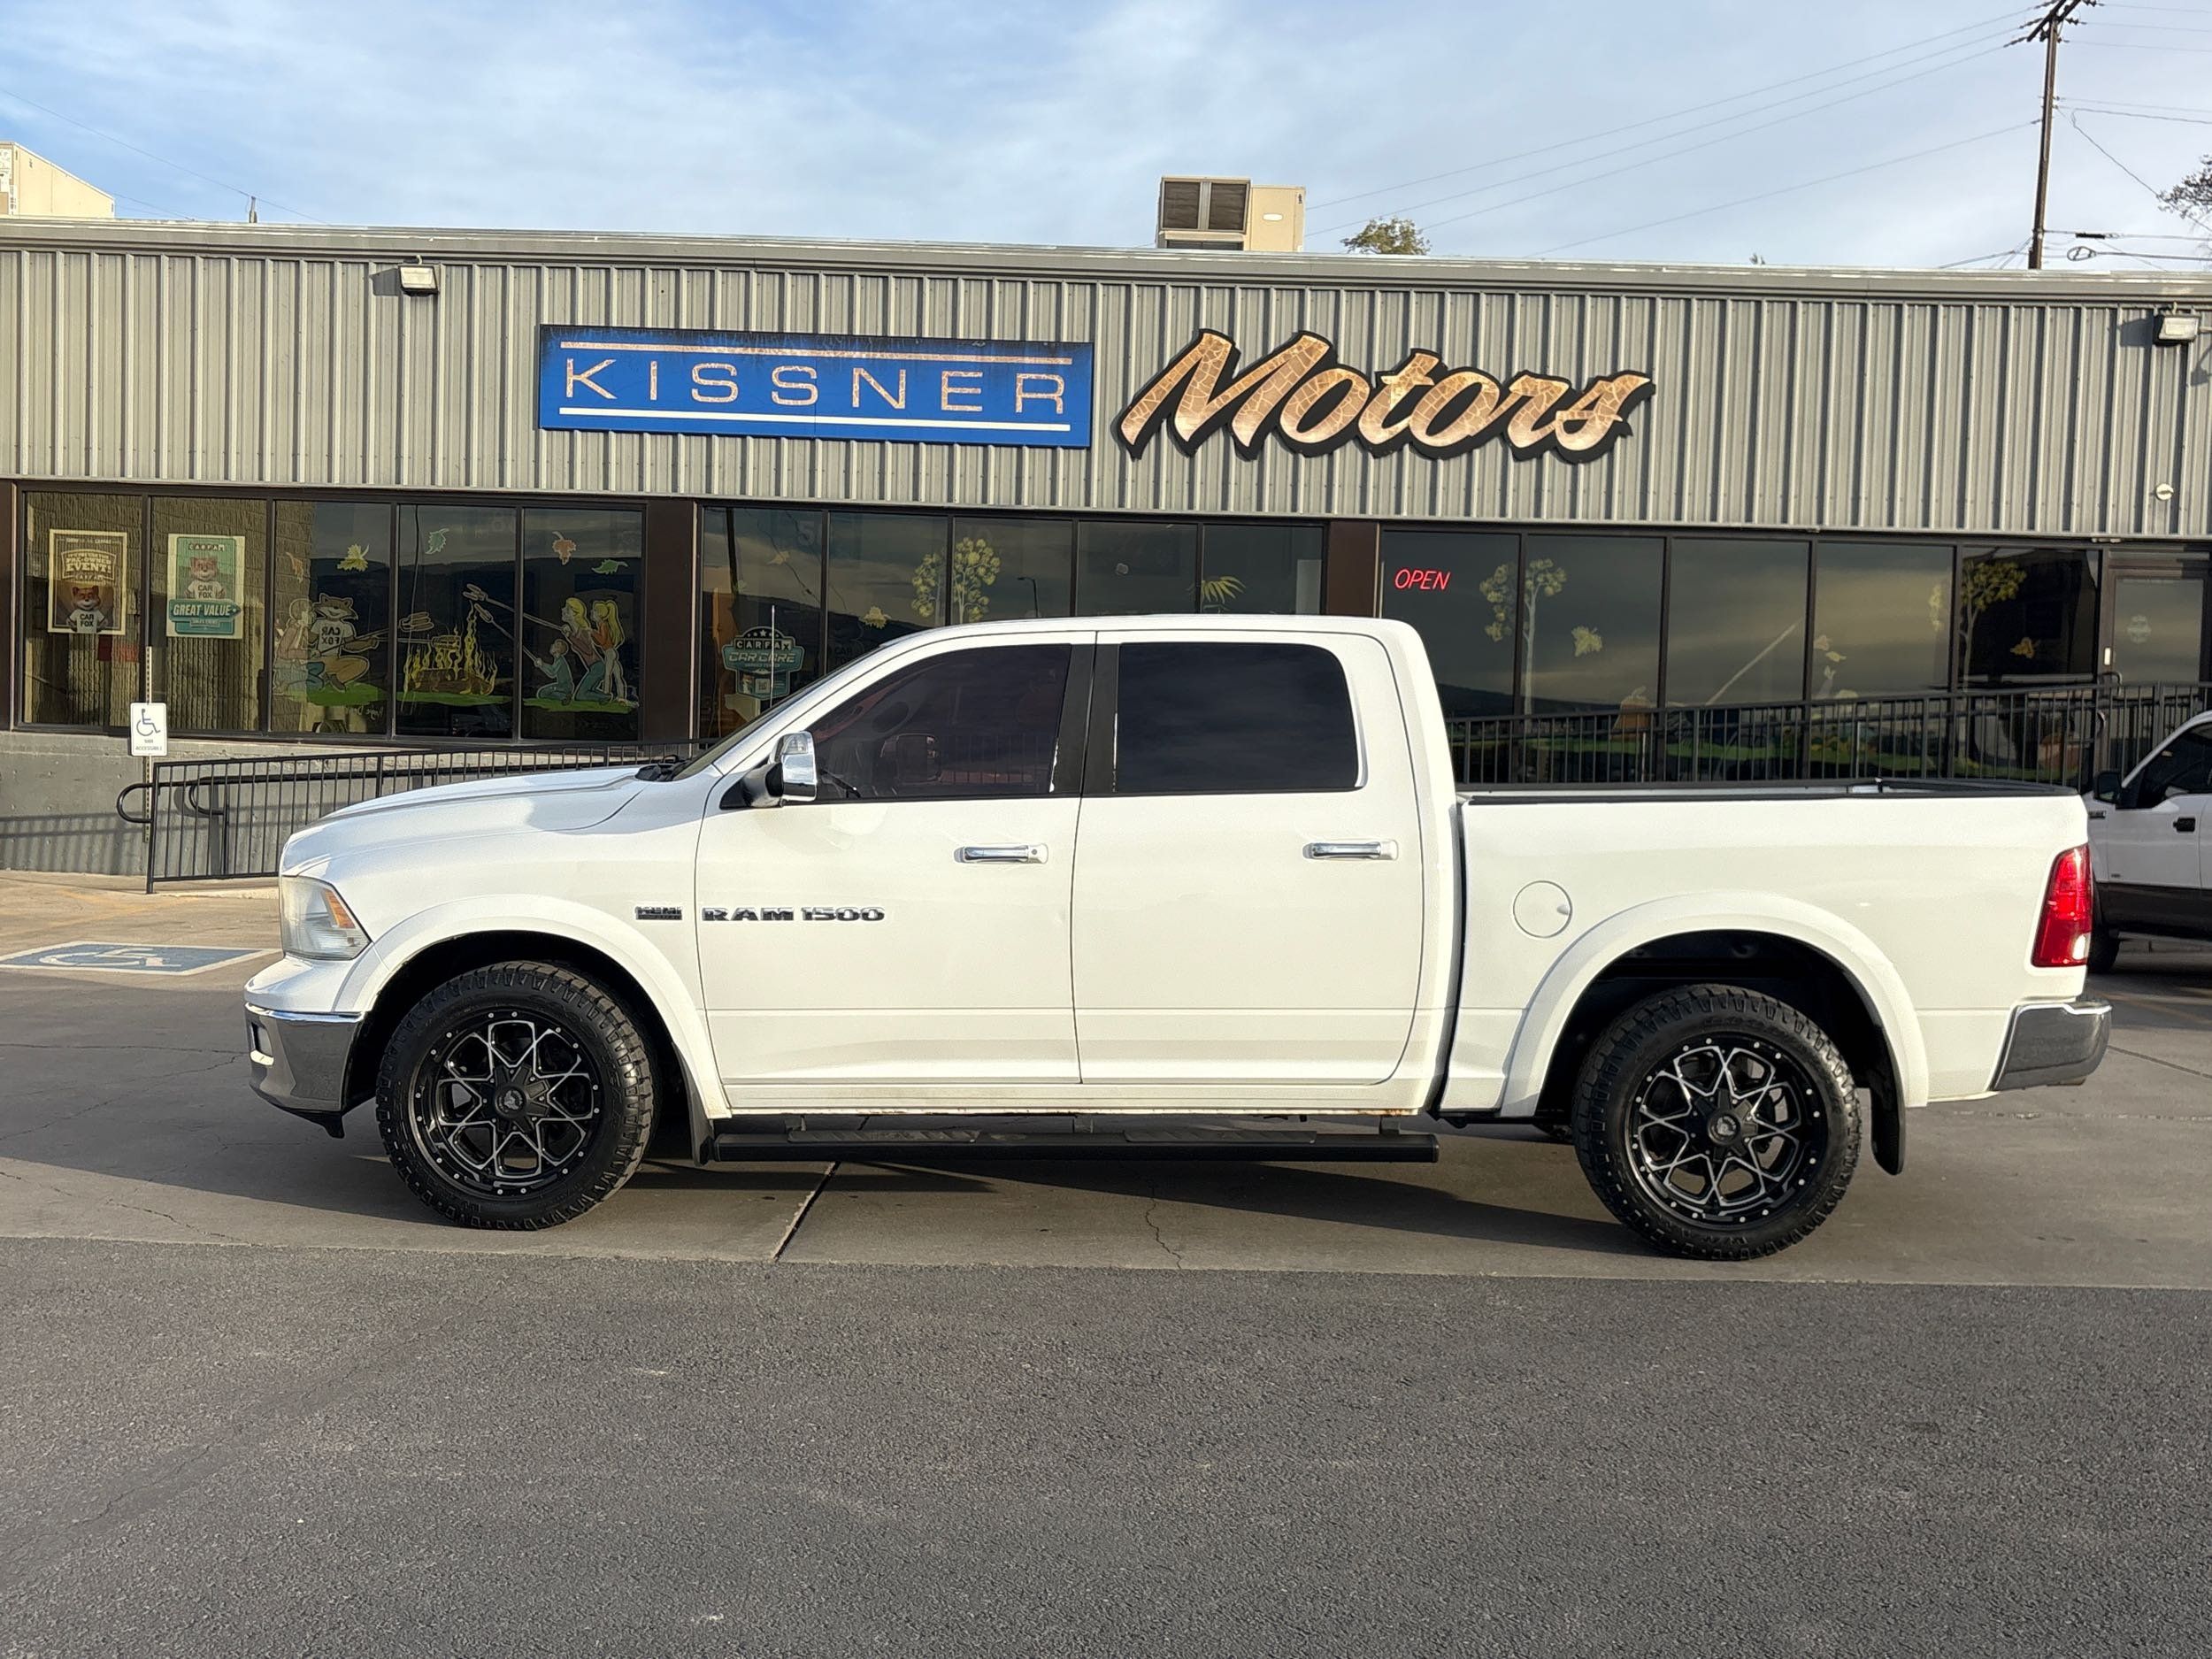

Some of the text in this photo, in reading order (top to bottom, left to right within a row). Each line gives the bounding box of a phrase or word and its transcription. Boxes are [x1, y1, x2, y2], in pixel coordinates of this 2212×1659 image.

[565, 357, 1065, 414] KISSNER
[1115, 329, 1655, 462] Motors
[65, 561, 111, 573] EVENT!
[1394, 568, 1451, 591] OPEN
[173, 603, 232, 617] GREAT VALUE
[735, 640, 792, 650] CARFAX
[728, 651, 796, 664] CAR CARE
[702, 907, 795, 922] RAM
[800, 907, 886, 922] 1500
